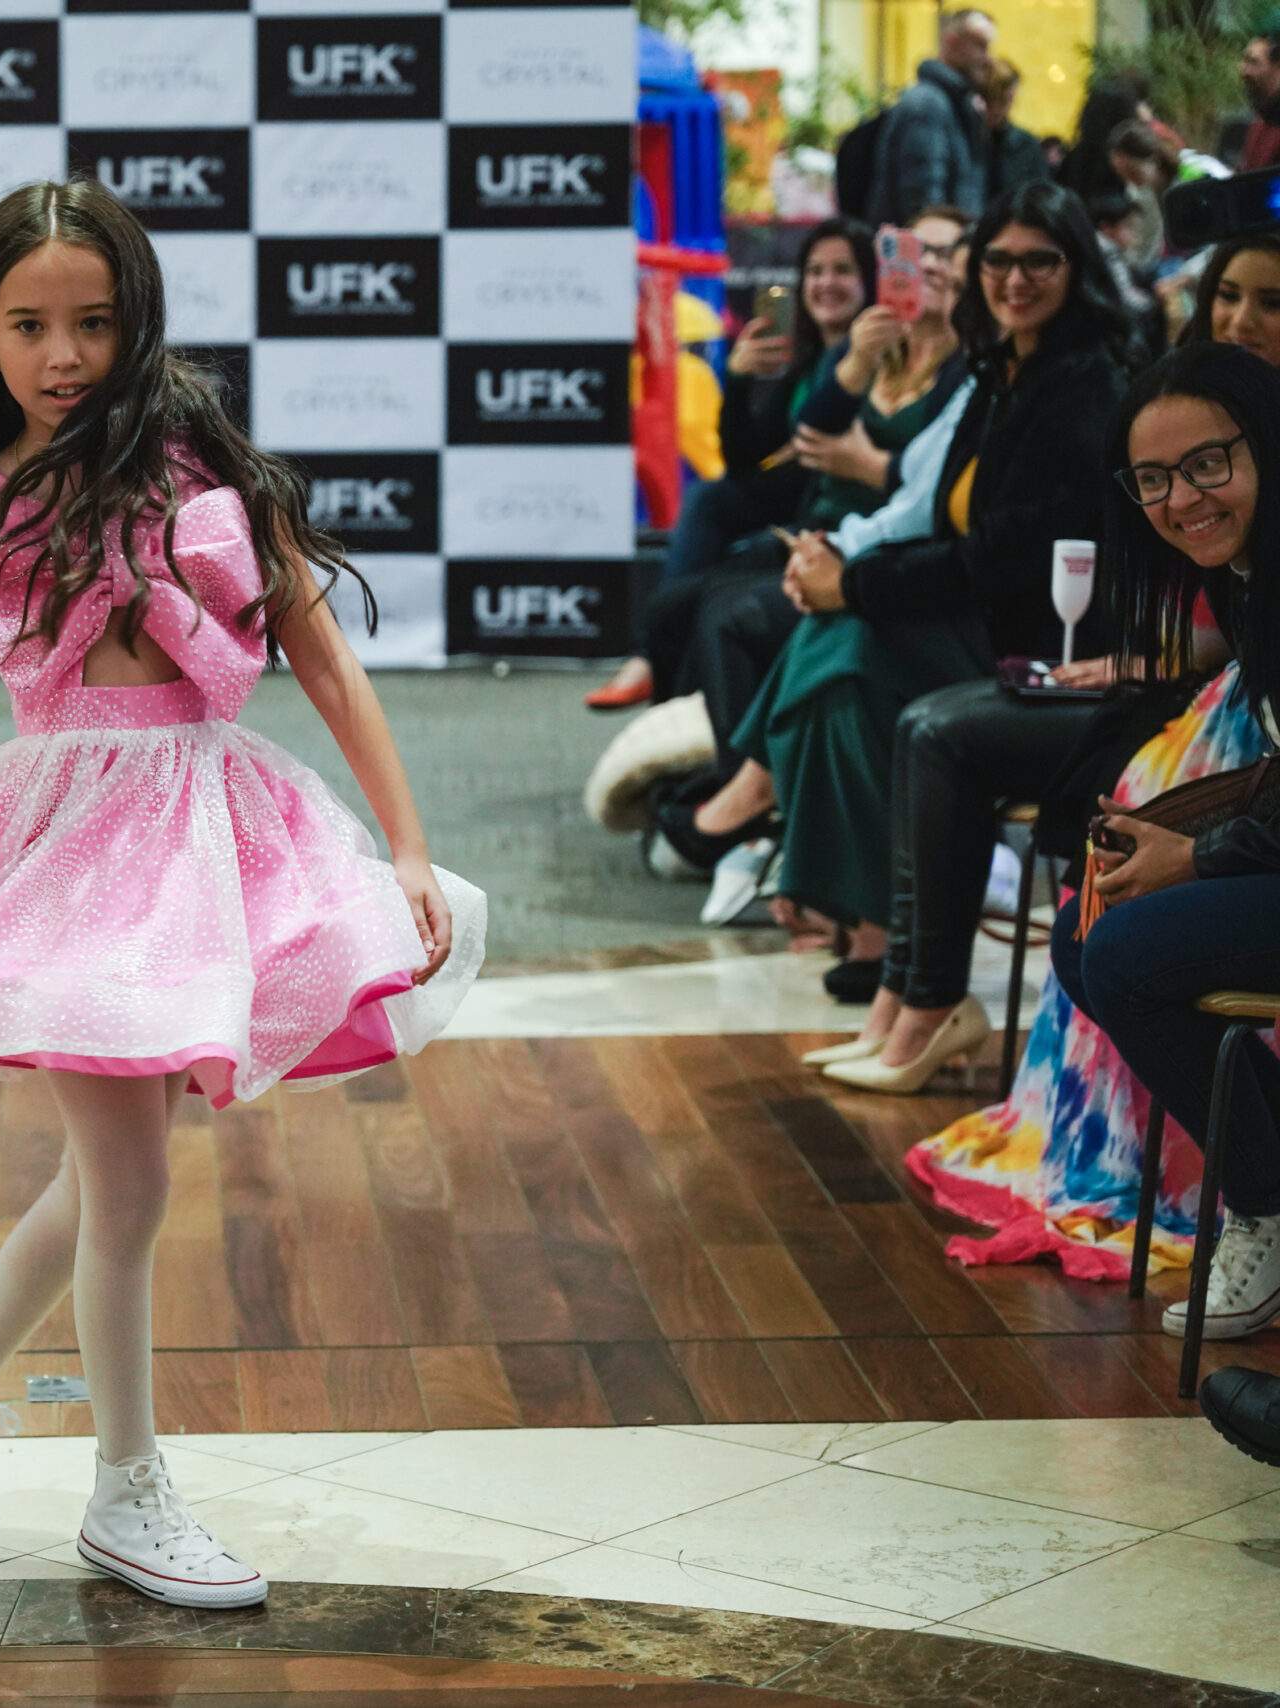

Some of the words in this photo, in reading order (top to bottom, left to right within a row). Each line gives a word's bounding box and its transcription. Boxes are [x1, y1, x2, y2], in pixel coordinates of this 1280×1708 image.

[287, 43, 402, 86] UFK
[476, 154, 592, 197] UFK
[287, 262, 402, 304] UFK
[476, 368, 592, 411] UFK
[472, 585, 586, 629] UFK
